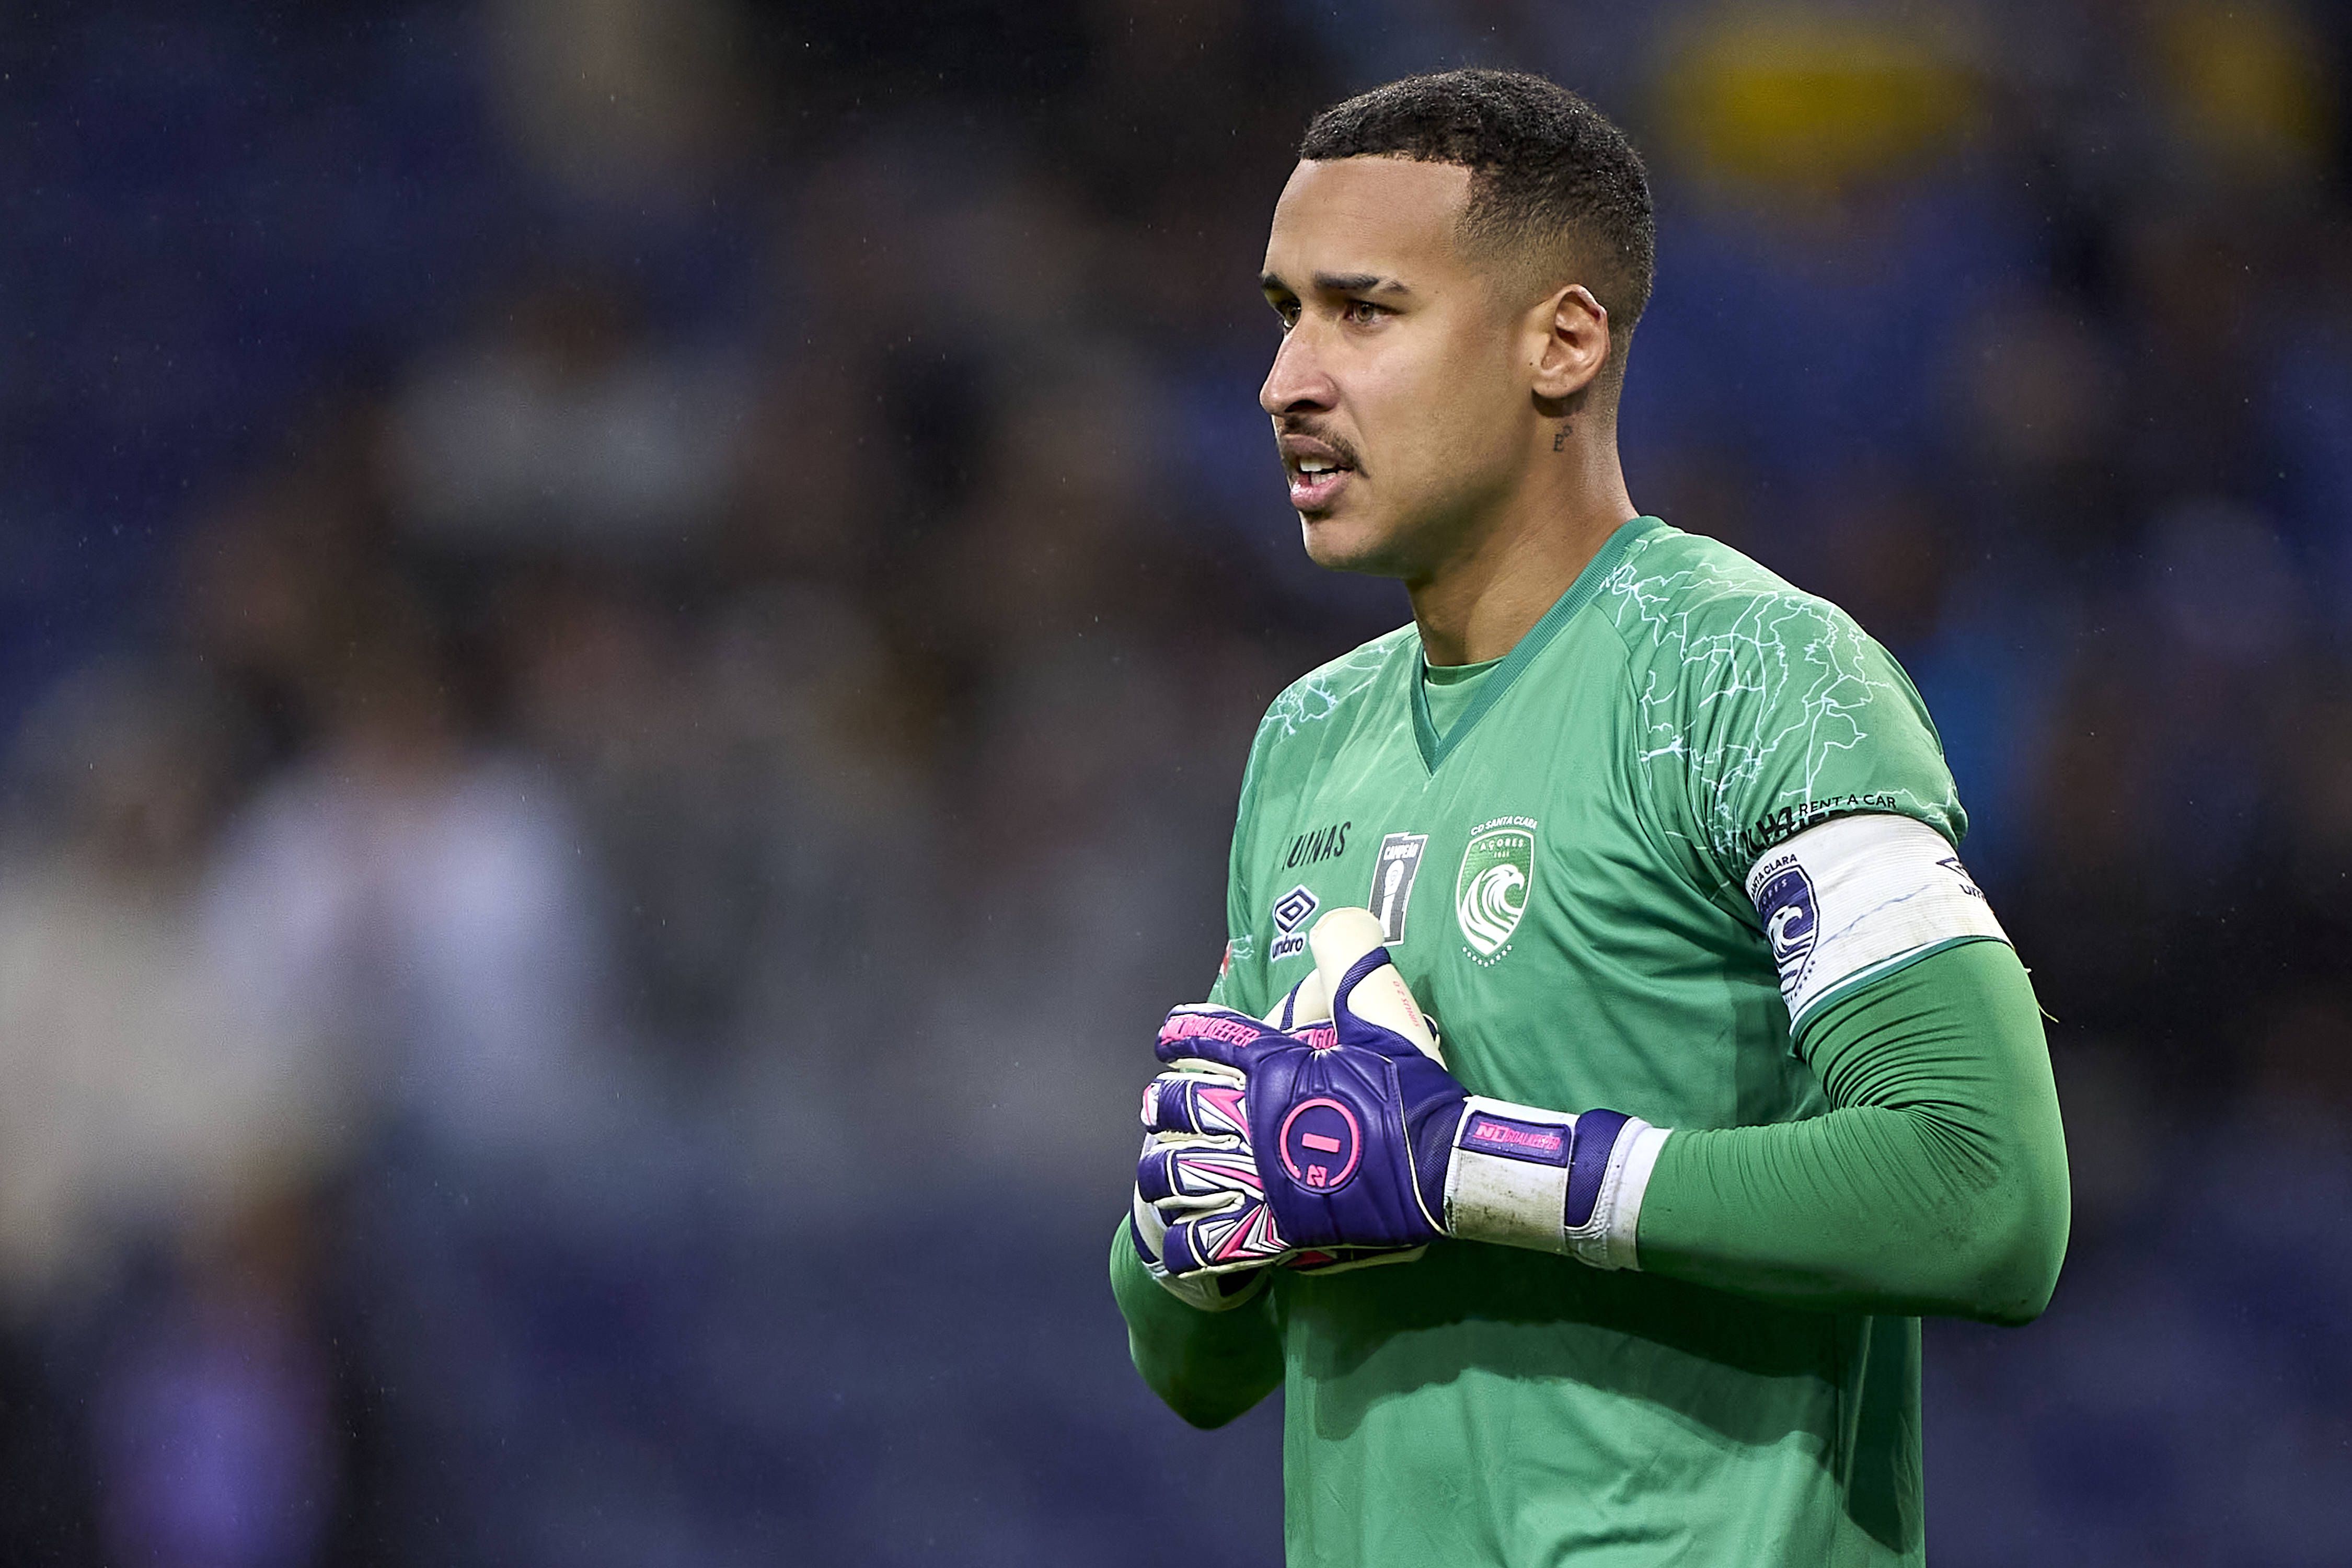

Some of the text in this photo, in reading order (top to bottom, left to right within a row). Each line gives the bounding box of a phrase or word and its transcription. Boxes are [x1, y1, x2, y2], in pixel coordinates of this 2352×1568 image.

[1799, 794, 1896, 816] RENT A CAR
[1485, 816, 1513, 830] SANTA
[1514, 816, 1538, 829] CLARA
[1282, 821, 1351, 873] UINAS
[1763, 854, 1797, 874] CLARA
